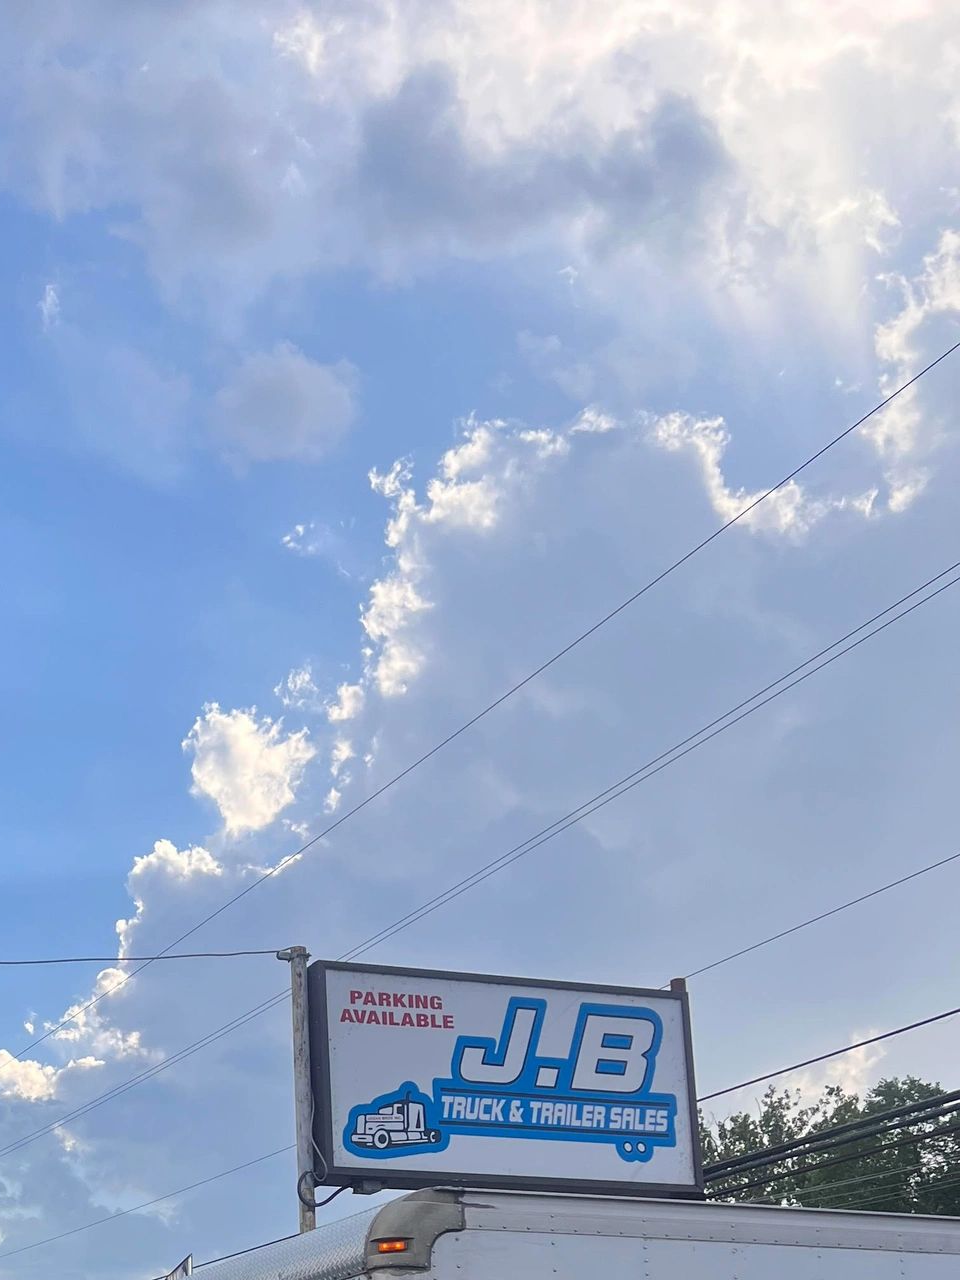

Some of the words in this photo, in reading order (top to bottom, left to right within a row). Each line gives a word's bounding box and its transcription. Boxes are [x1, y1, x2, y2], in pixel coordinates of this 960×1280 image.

[349, 990, 443, 1010] PARKING
[340, 1008, 455, 1029] AVAILABLE
[441, 1095, 505, 1122] TRUCK
[509, 1099, 524, 1123] &
[530, 1101, 607, 1129] TRAILER
[609, 1107, 669, 1132] SALES
